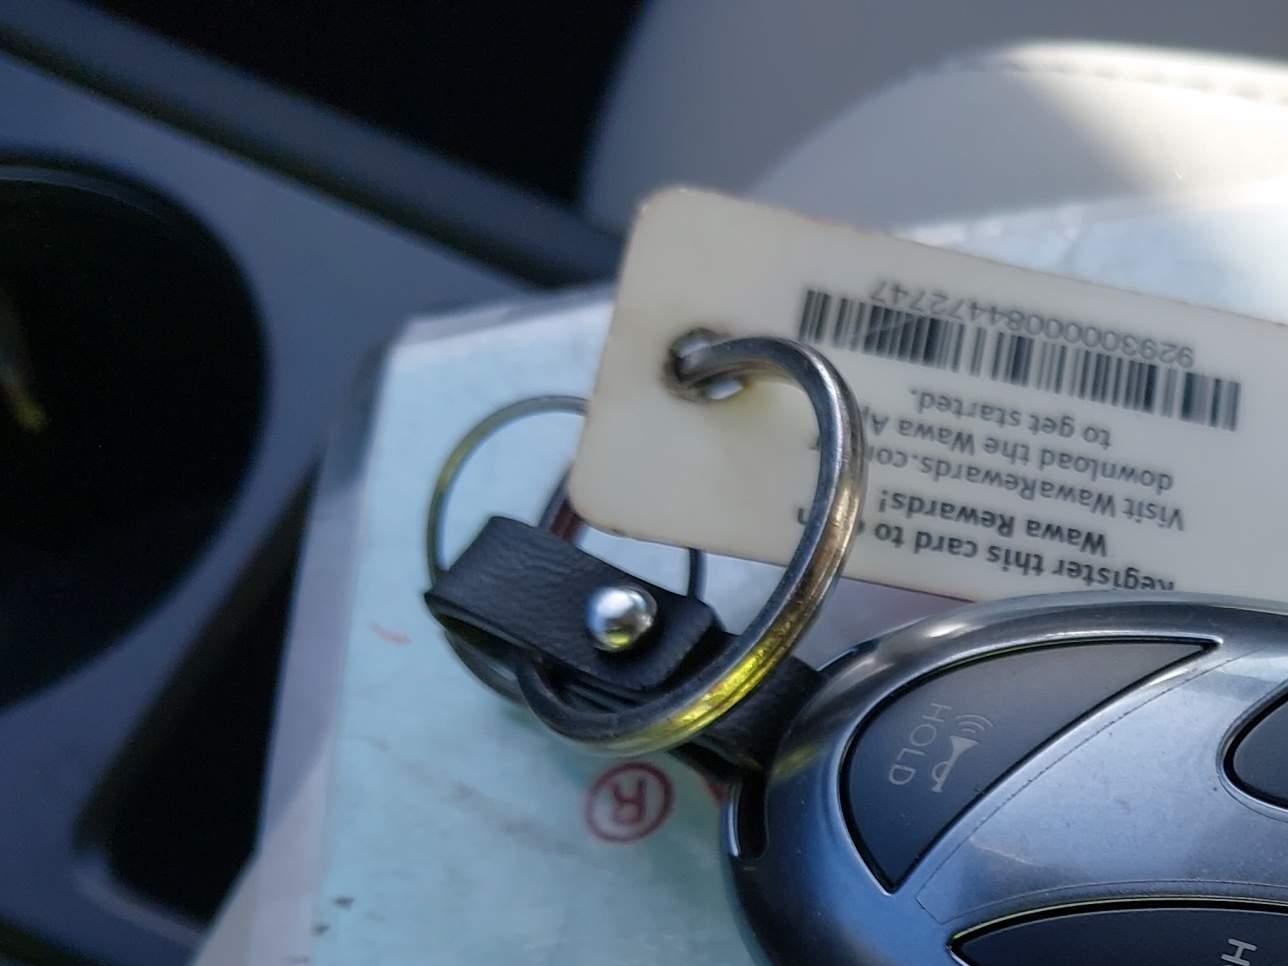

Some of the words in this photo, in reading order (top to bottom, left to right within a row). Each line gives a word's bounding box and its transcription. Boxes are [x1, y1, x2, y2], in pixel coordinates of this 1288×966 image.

[908, 387, 1020, 428] started.
[1029, 409, 1074, 439] get
[899, 421, 976, 456] Wawa
[984, 438, 1030, 464] the
[1083, 424, 1112, 449] to
[866, 444, 1115, 518] WawaRewards.co
[1039, 447, 1174, 492] download
[877, 488, 1015, 538] Rewards!
[1123, 495, 1185, 532] Visit
[874, 522, 904, 546] to
[914, 530, 977, 559] card
[1025, 517, 1107, 557] Wawa
[987, 546, 1046, 577] this
[888, 702, 952, 785] HOLD
